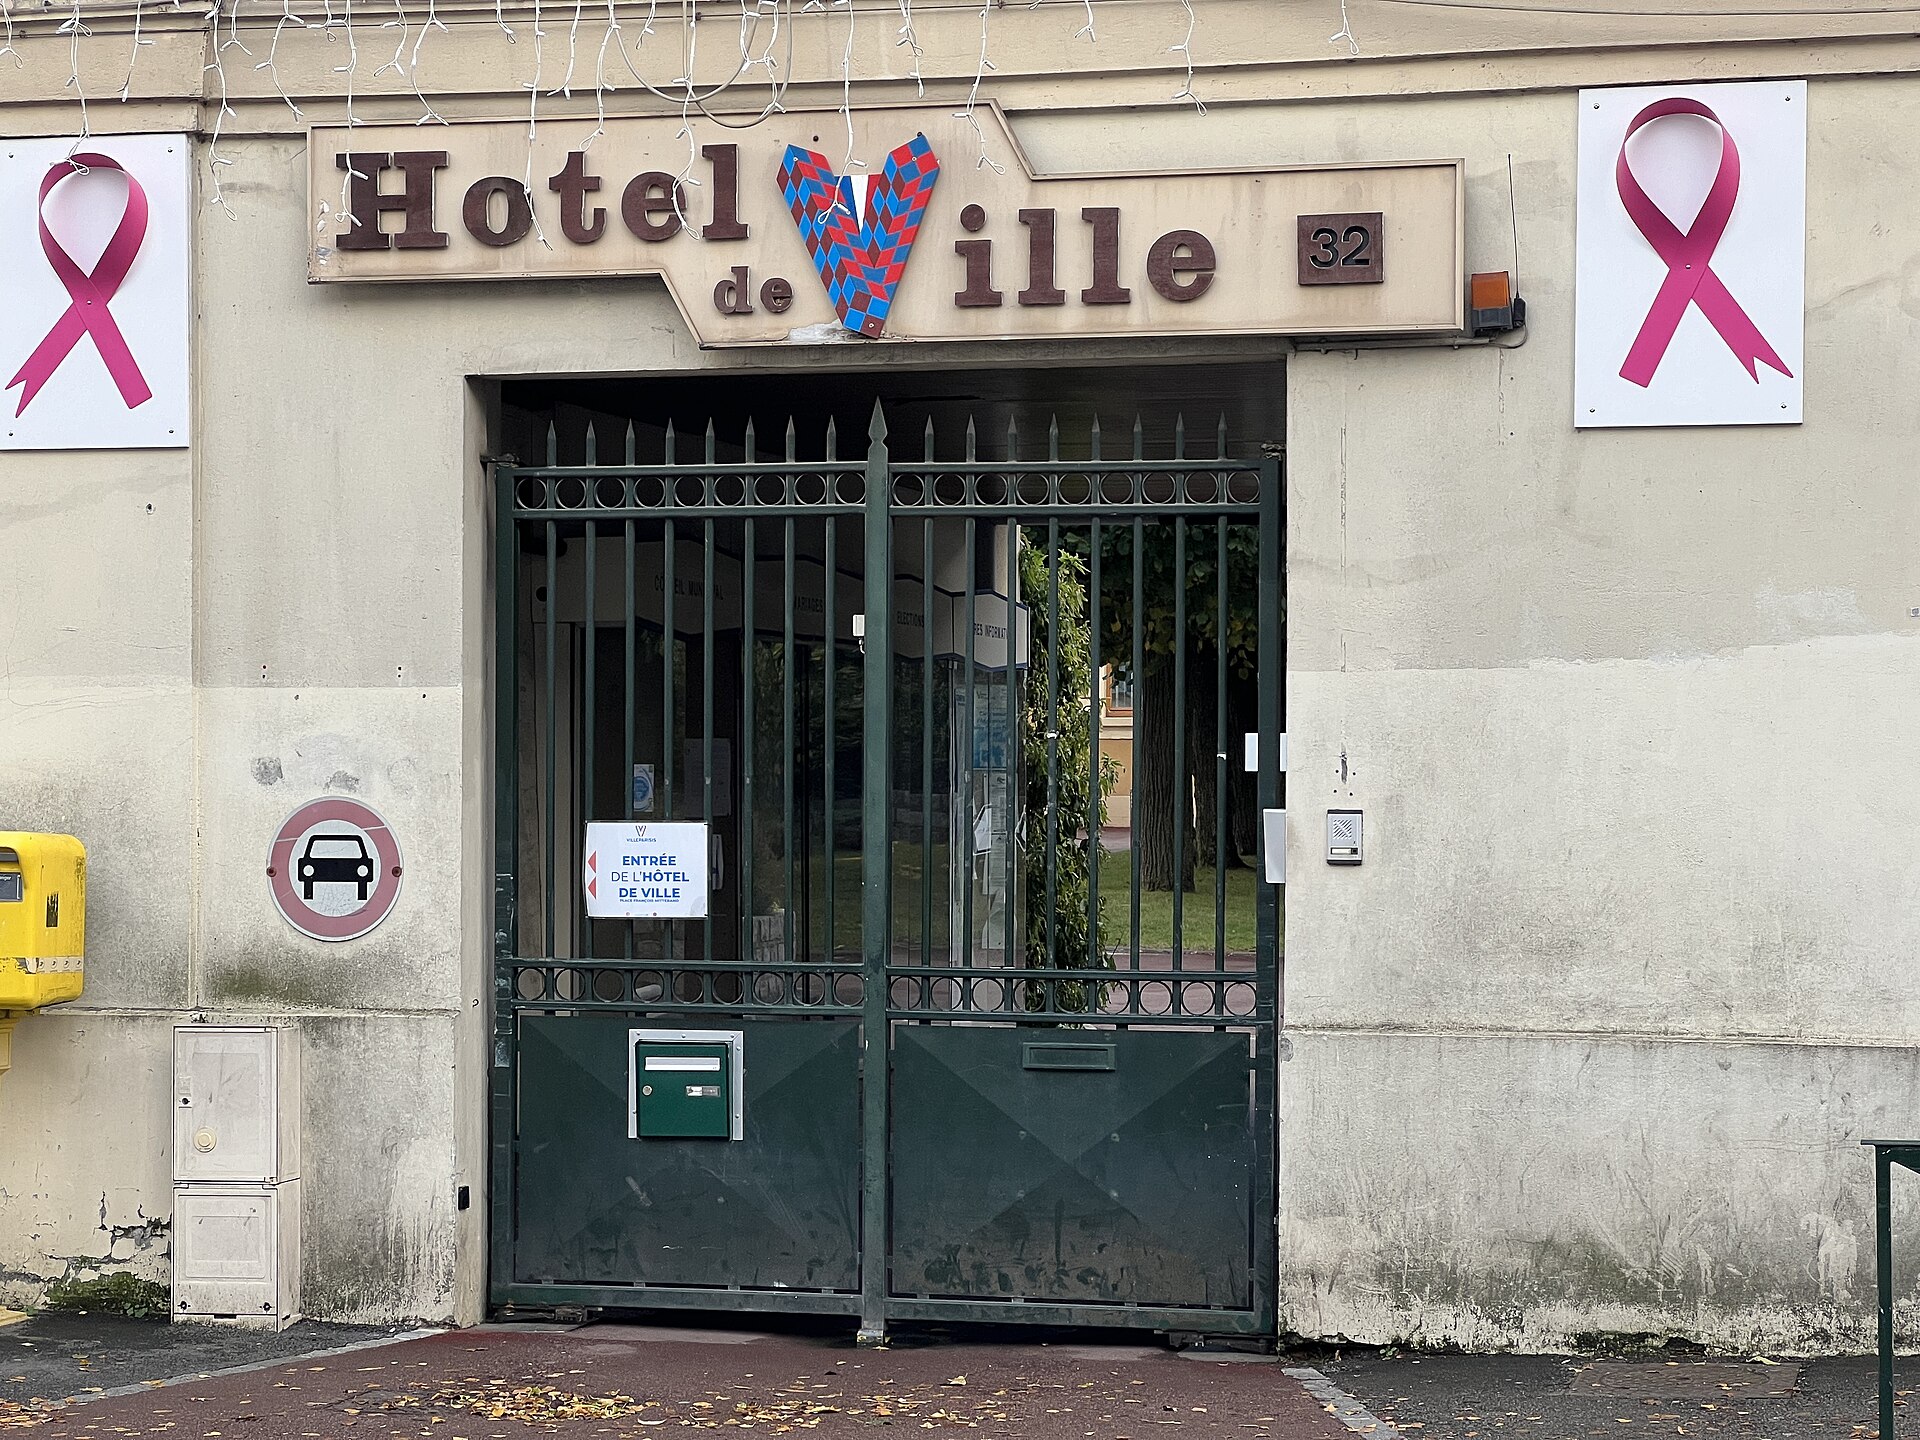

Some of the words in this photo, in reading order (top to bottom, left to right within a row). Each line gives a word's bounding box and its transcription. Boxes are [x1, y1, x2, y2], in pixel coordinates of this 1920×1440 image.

[336, 144, 749, 251] Hotel
[713, 266, 793, 314] de
[1309, 226, 1372, 269] 32
[622, 853, 677, 866] ENTRÉE
[611, 871, 629, 882] DE
[633, 869, 690, 882] L'HÔTEL
[619, 887, 637, 898] DE
[641, 887, 681, 898] VILLE
